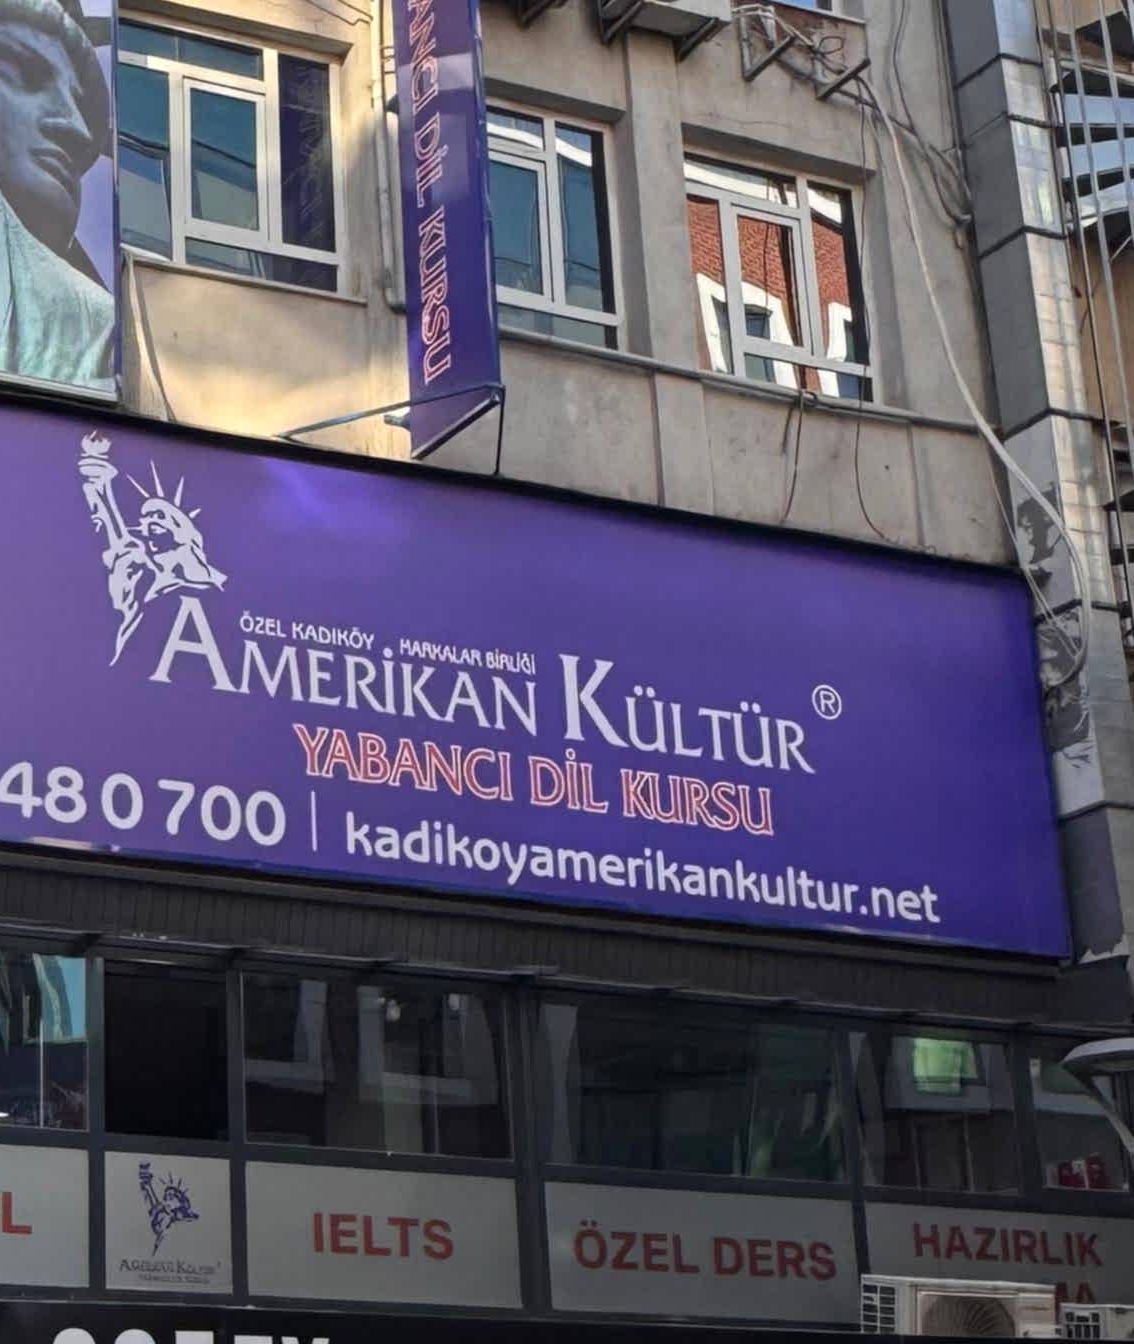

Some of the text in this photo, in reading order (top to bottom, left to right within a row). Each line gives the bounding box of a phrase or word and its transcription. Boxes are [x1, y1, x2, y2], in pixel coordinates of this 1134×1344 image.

[414, 115, 450, 208] DİL
[418, 205, 451, 385] KURSU
[240, 611, 374, 651] ÖZEL KADIKÖY
[149, 595, 537, 737] AMERİKAN
[559, 653, 816, 774] KÜLTÜR
[158, 779, 287, 847] 700
[293, 723, 774, 837] YABANCI DİL KURSU
[346, 812, 941, 923] kadikoyamerikankultur.net
[312, 1211, 454, 1262] IELTS
[573, 1219, 837, 1281] ÖZEL DERS
[911, 1221, 1105, 1268] HAZIRLIK
